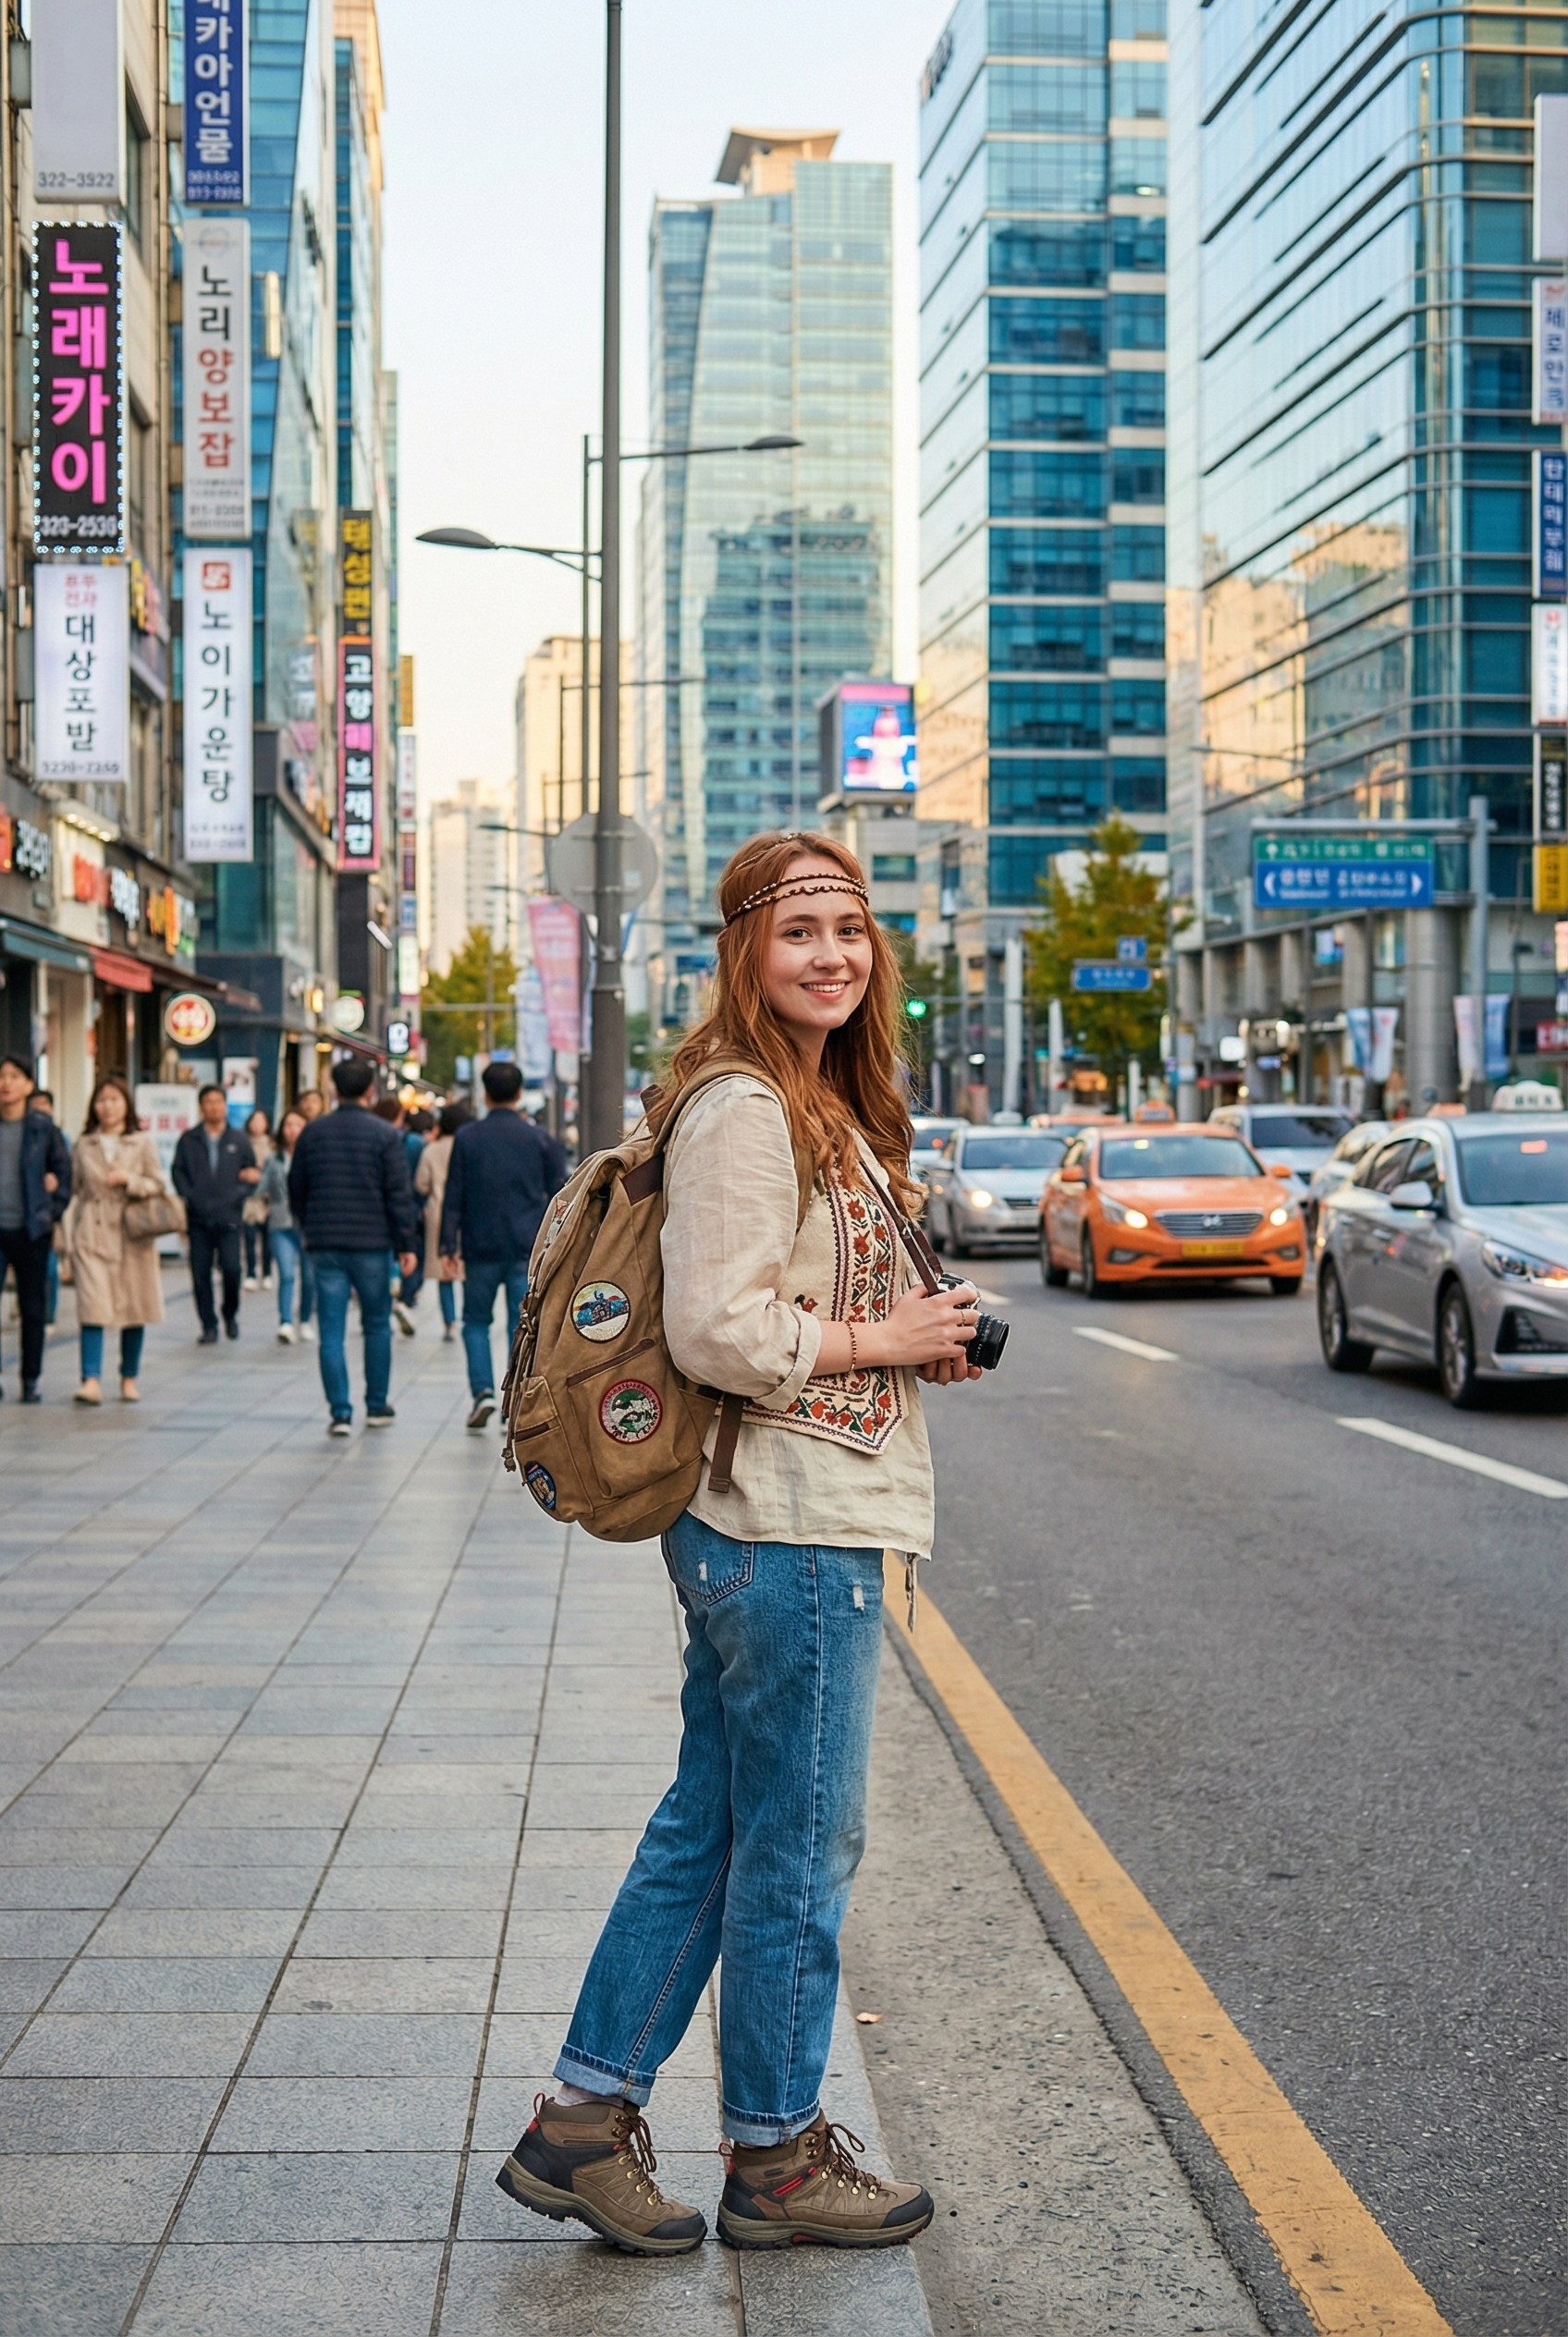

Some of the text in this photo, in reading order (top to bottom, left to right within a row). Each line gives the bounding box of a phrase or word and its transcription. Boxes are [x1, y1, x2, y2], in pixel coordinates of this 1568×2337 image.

[49, 238, 111, 504] 노래카이
[197, 264, 234, 469] 노리양보잡
[66, 614, 97, 752] 대상포발
[201, 601, 234, 802] 노이가운탕
